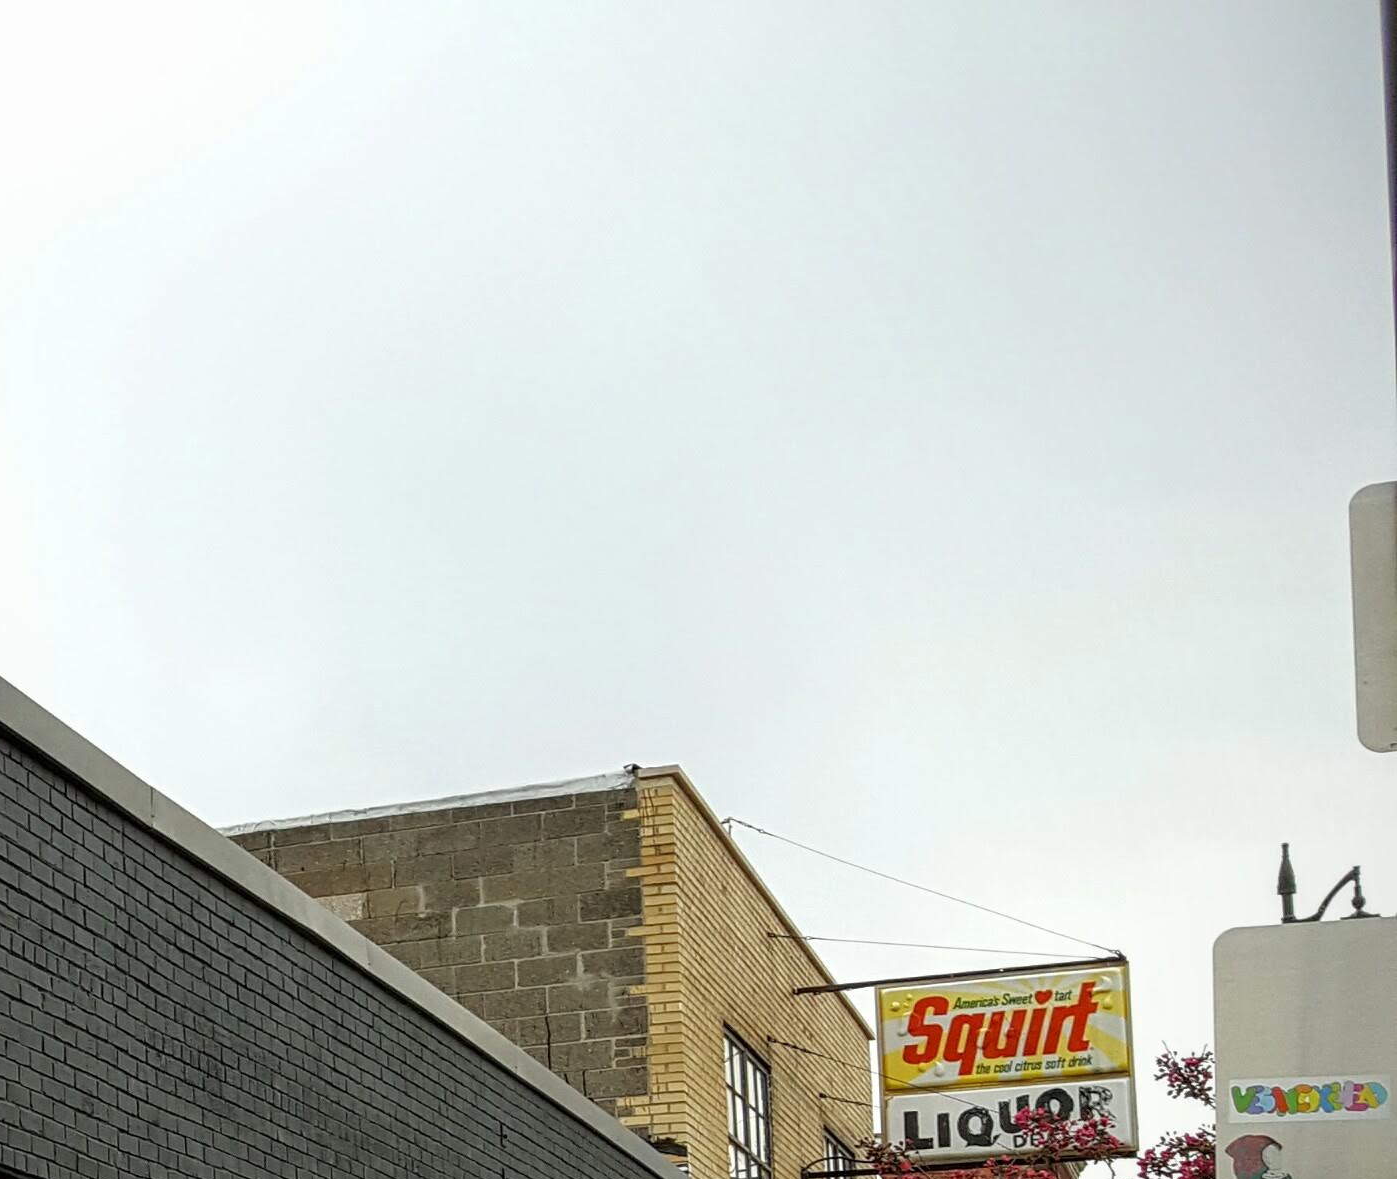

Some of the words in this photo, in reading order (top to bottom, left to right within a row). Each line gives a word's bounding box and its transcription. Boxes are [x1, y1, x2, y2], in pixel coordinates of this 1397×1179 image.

[953, 996, 1000, 1010] America's
[1001, 993, 1033, 1006] Sweet
[903, 981, 1100, 1076] Squirt
[975, 1063, 991, 1074] the
[993, 1061, 1013, 1073] cool
[1014, 1060, 1043, 1072] citrus
[1044, 1057, 1067, 1069] soft
[1068, 1054, 1093, 1067] drink
[904, 1086, 1117, 1150] LIQUOR
